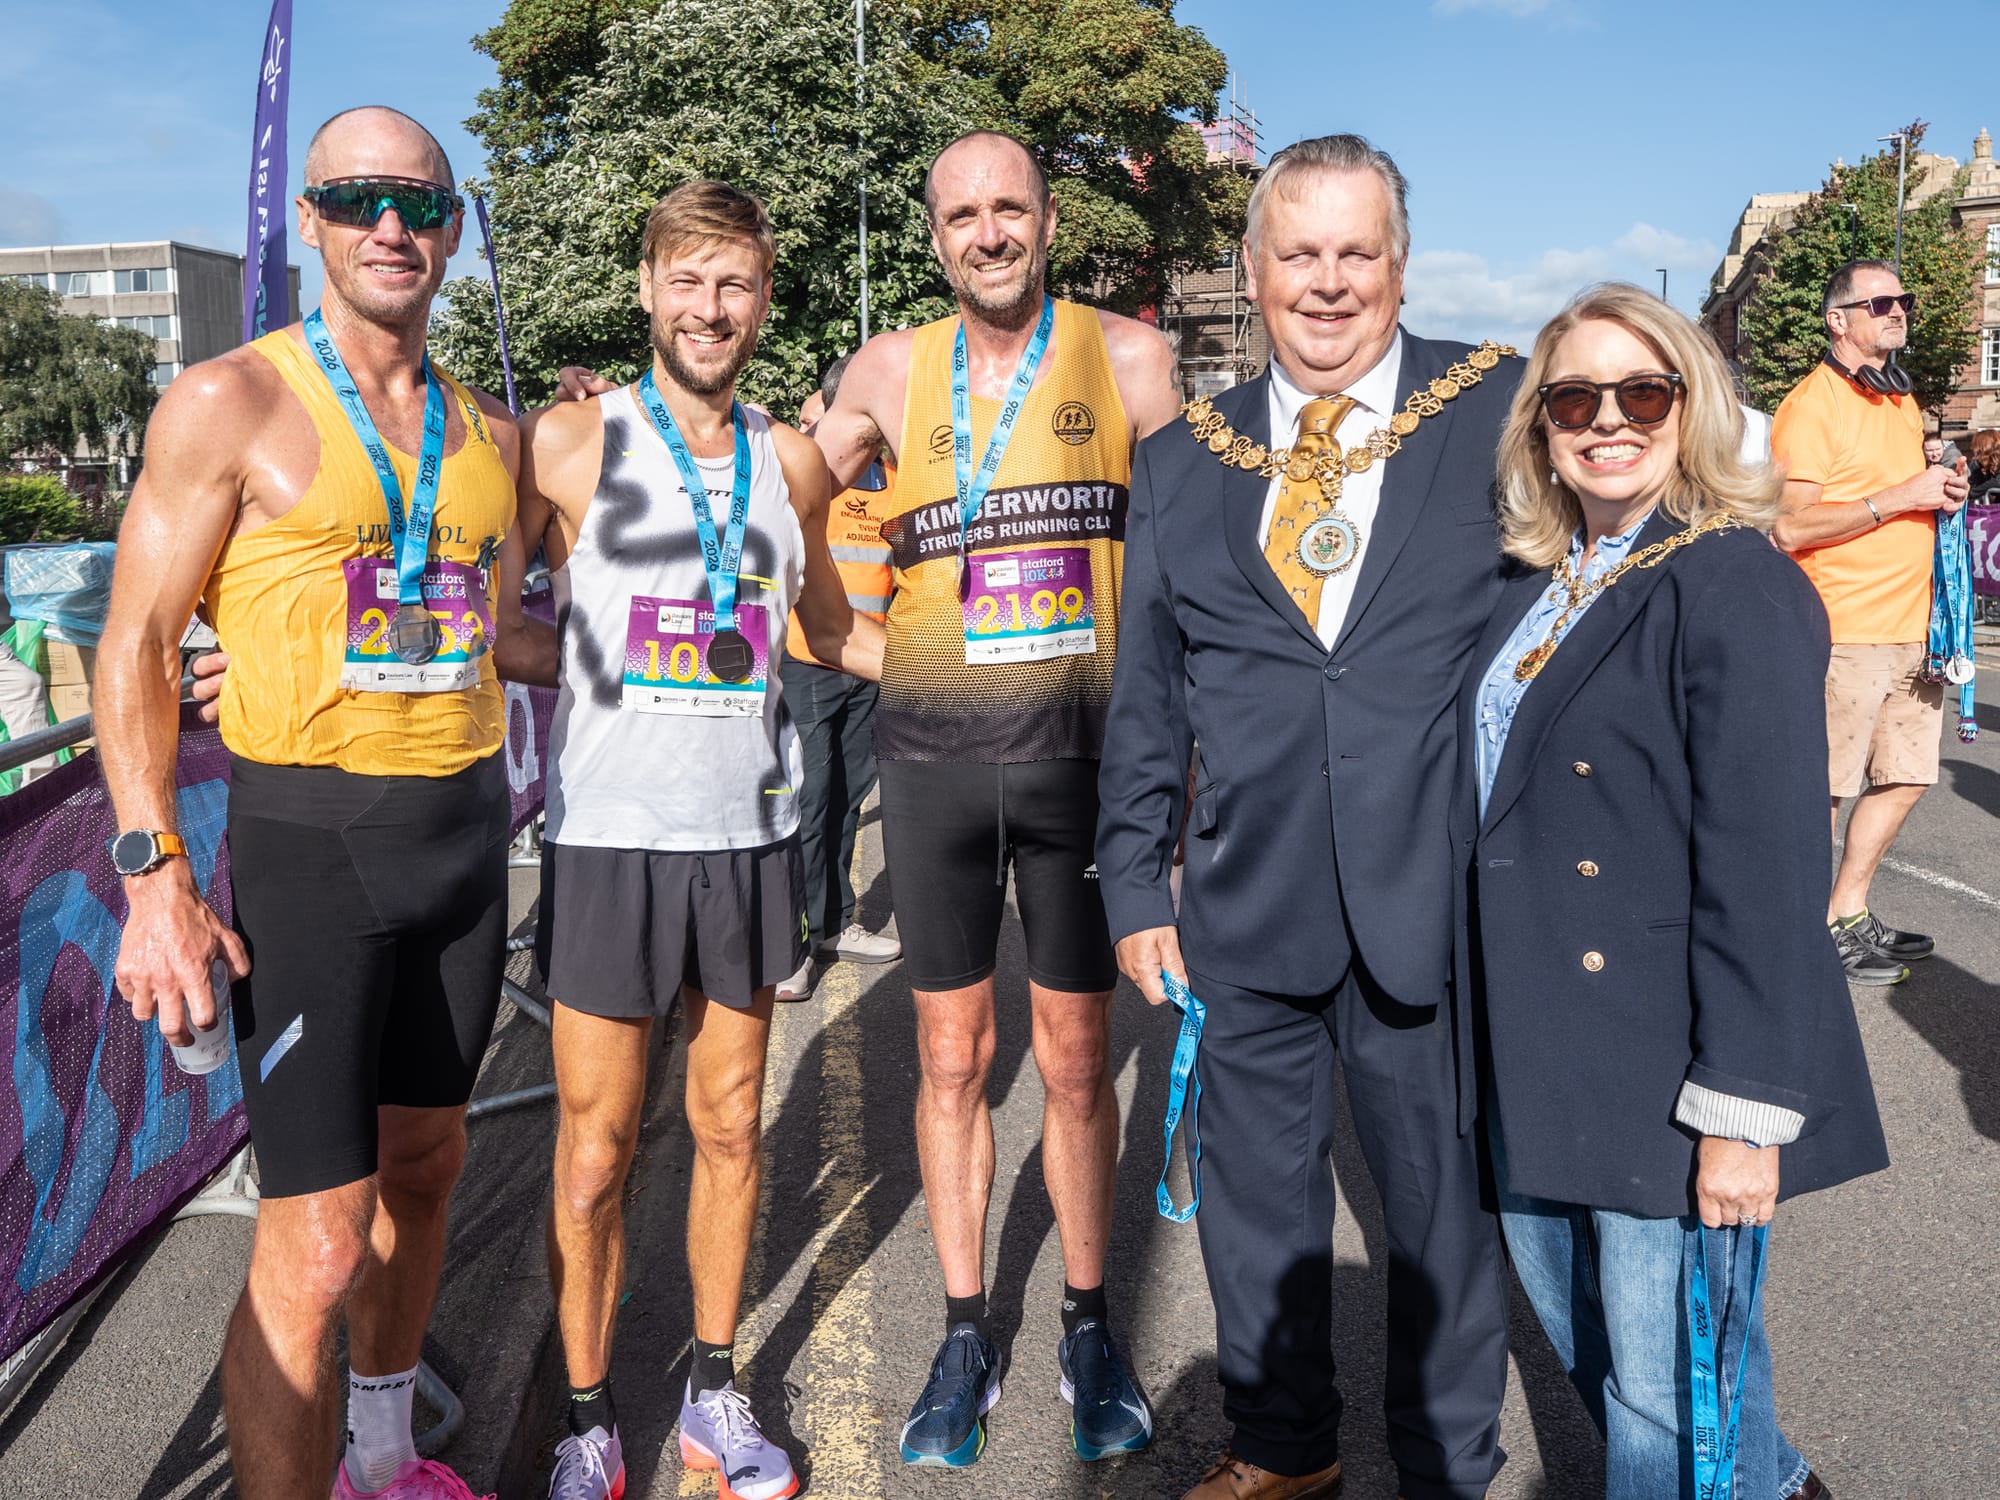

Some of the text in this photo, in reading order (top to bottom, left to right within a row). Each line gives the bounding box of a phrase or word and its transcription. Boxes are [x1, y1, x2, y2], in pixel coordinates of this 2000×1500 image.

[315, 338, 341, 371] 2026
[651, 403, 673, 431] 2026
[1000, 400, 1020, 430] 2026
[366, 443, 382, 462] 10K
[955, 435, 965, 452] 10K
[928, 454, 956, 465] SCIMIT
[982, 441, 997, 470] stafford
[986, 455, 1001, 473] 10K
[420, 453, 438, 487] 2026
[676, 485, 734, 498] SOTT
[690, 492, 703, 511] 10K
[959, 479, 969, 510] 2026
[390, 495, 405, 534] 2026
[408, 502, 421, 538] stafford
[731, 496, 746, 526] 2026
[356, 523, 468, 545] LIVOL
[415, 517, 429, 539] 10K
[846, 533, 886, 544] ADJUDICA
[1000, 517, 1081, 538] RUNNING
[704, 539, 720, 573] 2026
[727, 555, 739, 573] 10K
[1021, 555, 1065, 570] stafford
[1023, 568, 1047, 583] 10K
[423, 584, 445, 599] 0K
[697, 610, 741, 623] stad
[973, 586, 1085, 635] 2199
[359, 607, 485, 656] 253
[732, 697, 759, 706] Stafford
[1165, 1107, 1178, 1130] 026
[1694, 1297, 1709, 1339] 2026
[1695, 1425, 1708, 1448] 10K
[1707, 1426, 1720, 1463] stafford
